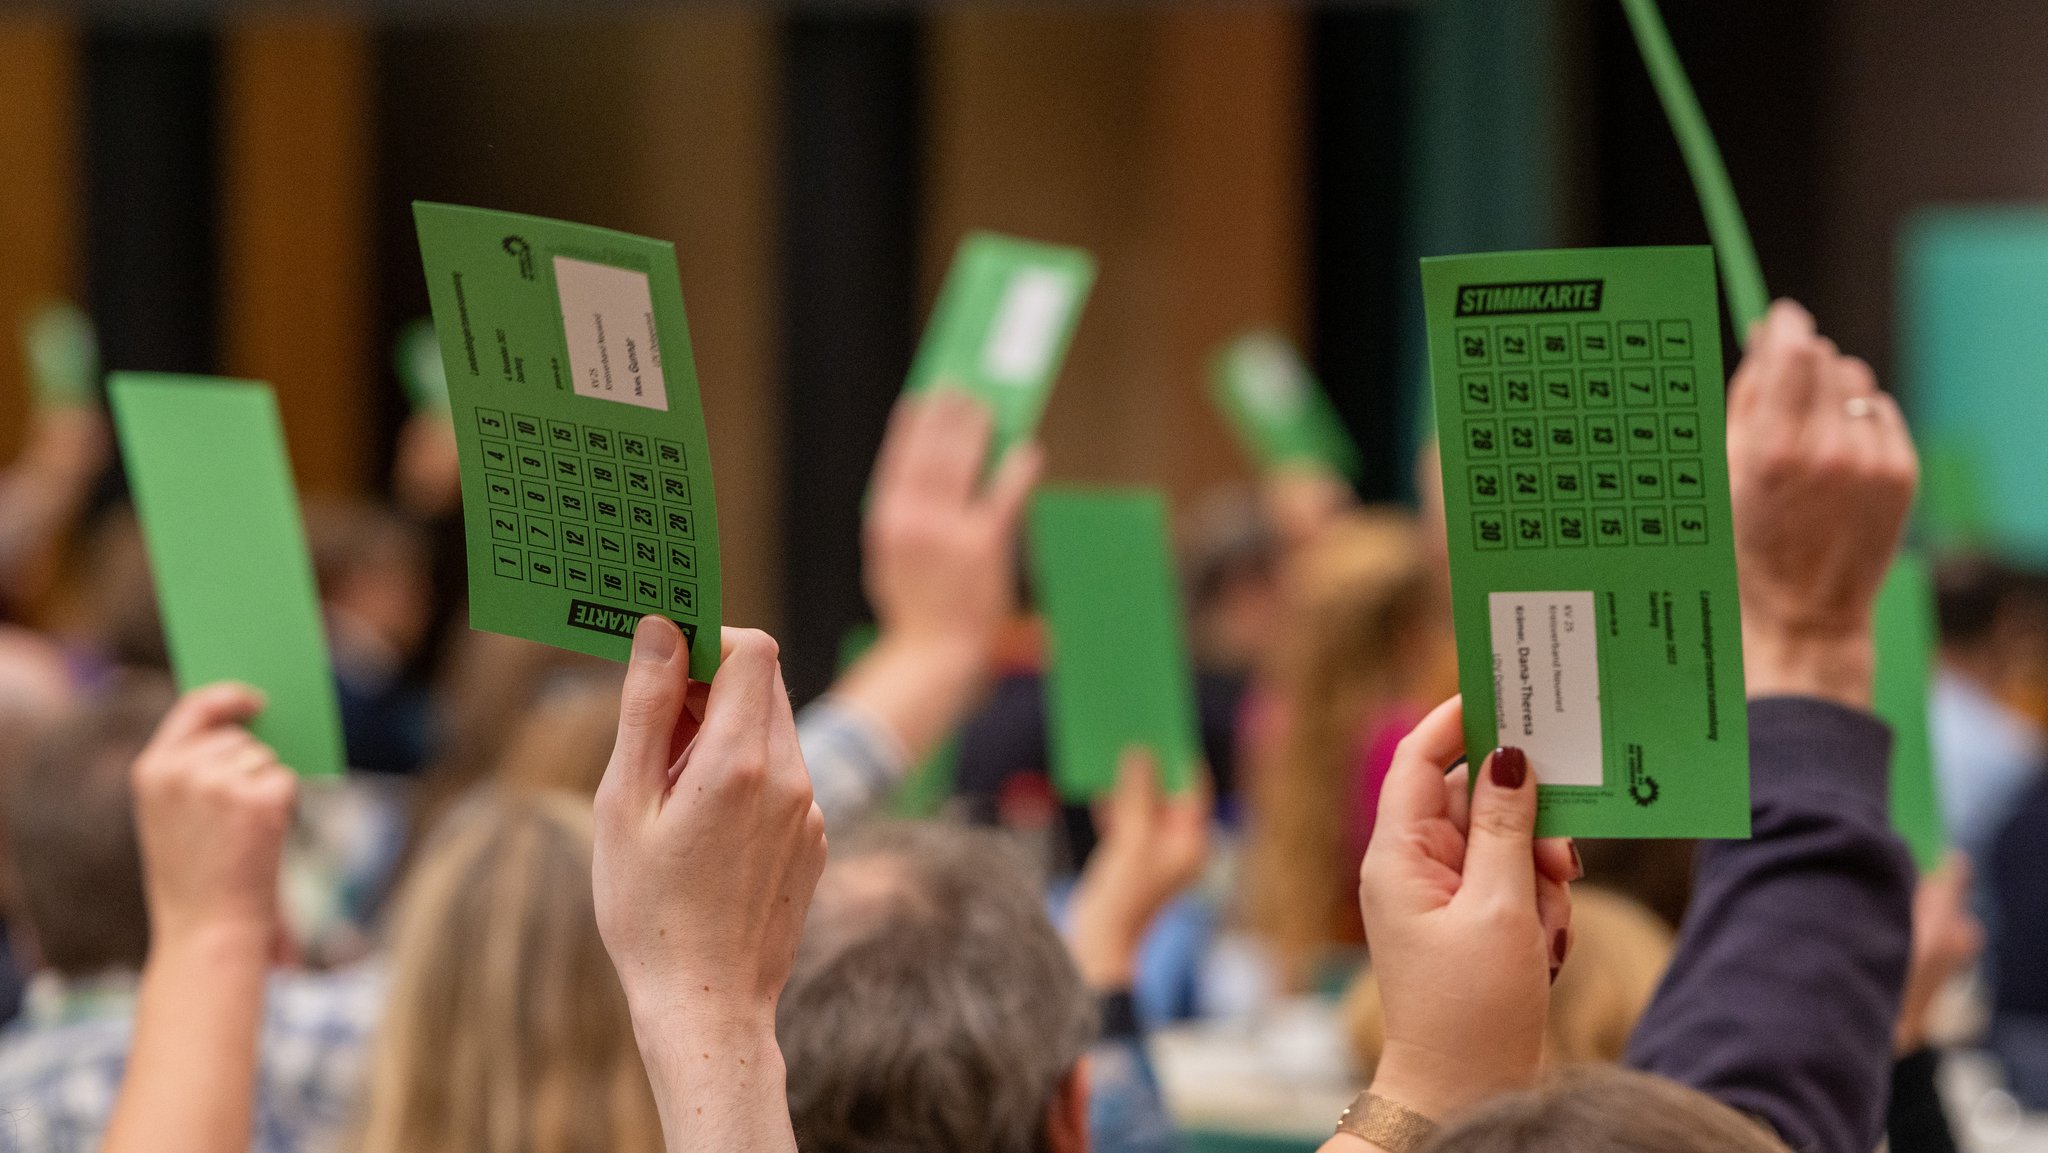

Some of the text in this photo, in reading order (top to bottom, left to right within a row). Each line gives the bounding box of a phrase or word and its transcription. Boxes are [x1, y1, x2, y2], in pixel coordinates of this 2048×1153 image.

[1461, 286, 1597, 313] STIMMKARTE
[1464, 337, 1501, 541] 26 27 28 29 30
[1504, 337, 1541, 539] 21 22 23 24 25
[1546, 337, 1581, 538] 16 17 18 19 20
[1586, 337, 1621, 535] 11 12 13 14 15
[1626, 336, 1661, 535] 6 7 8 9 10
[1670, 381, 1690, 392] 2
[1674, 428, 1693, 438] 3
[482, 418, 516, 565] 1 2 3 4 5
[517, 421, 551, 574] 6 7 8 9 10
[553, 428, 586, 581] 11 12 13 14 15
[589, 433, 621, 590] 16 17 18 19 20
[625, 439, 656, 599] 21 22 23 24 25
[661, 445, 691, 608] 26 27 28 29 30
[1679, 474, 1697, 484] 4
[1681, 520, 1701, 530] 5
[1517, 646, 1534, 736] Dana-Theresa
